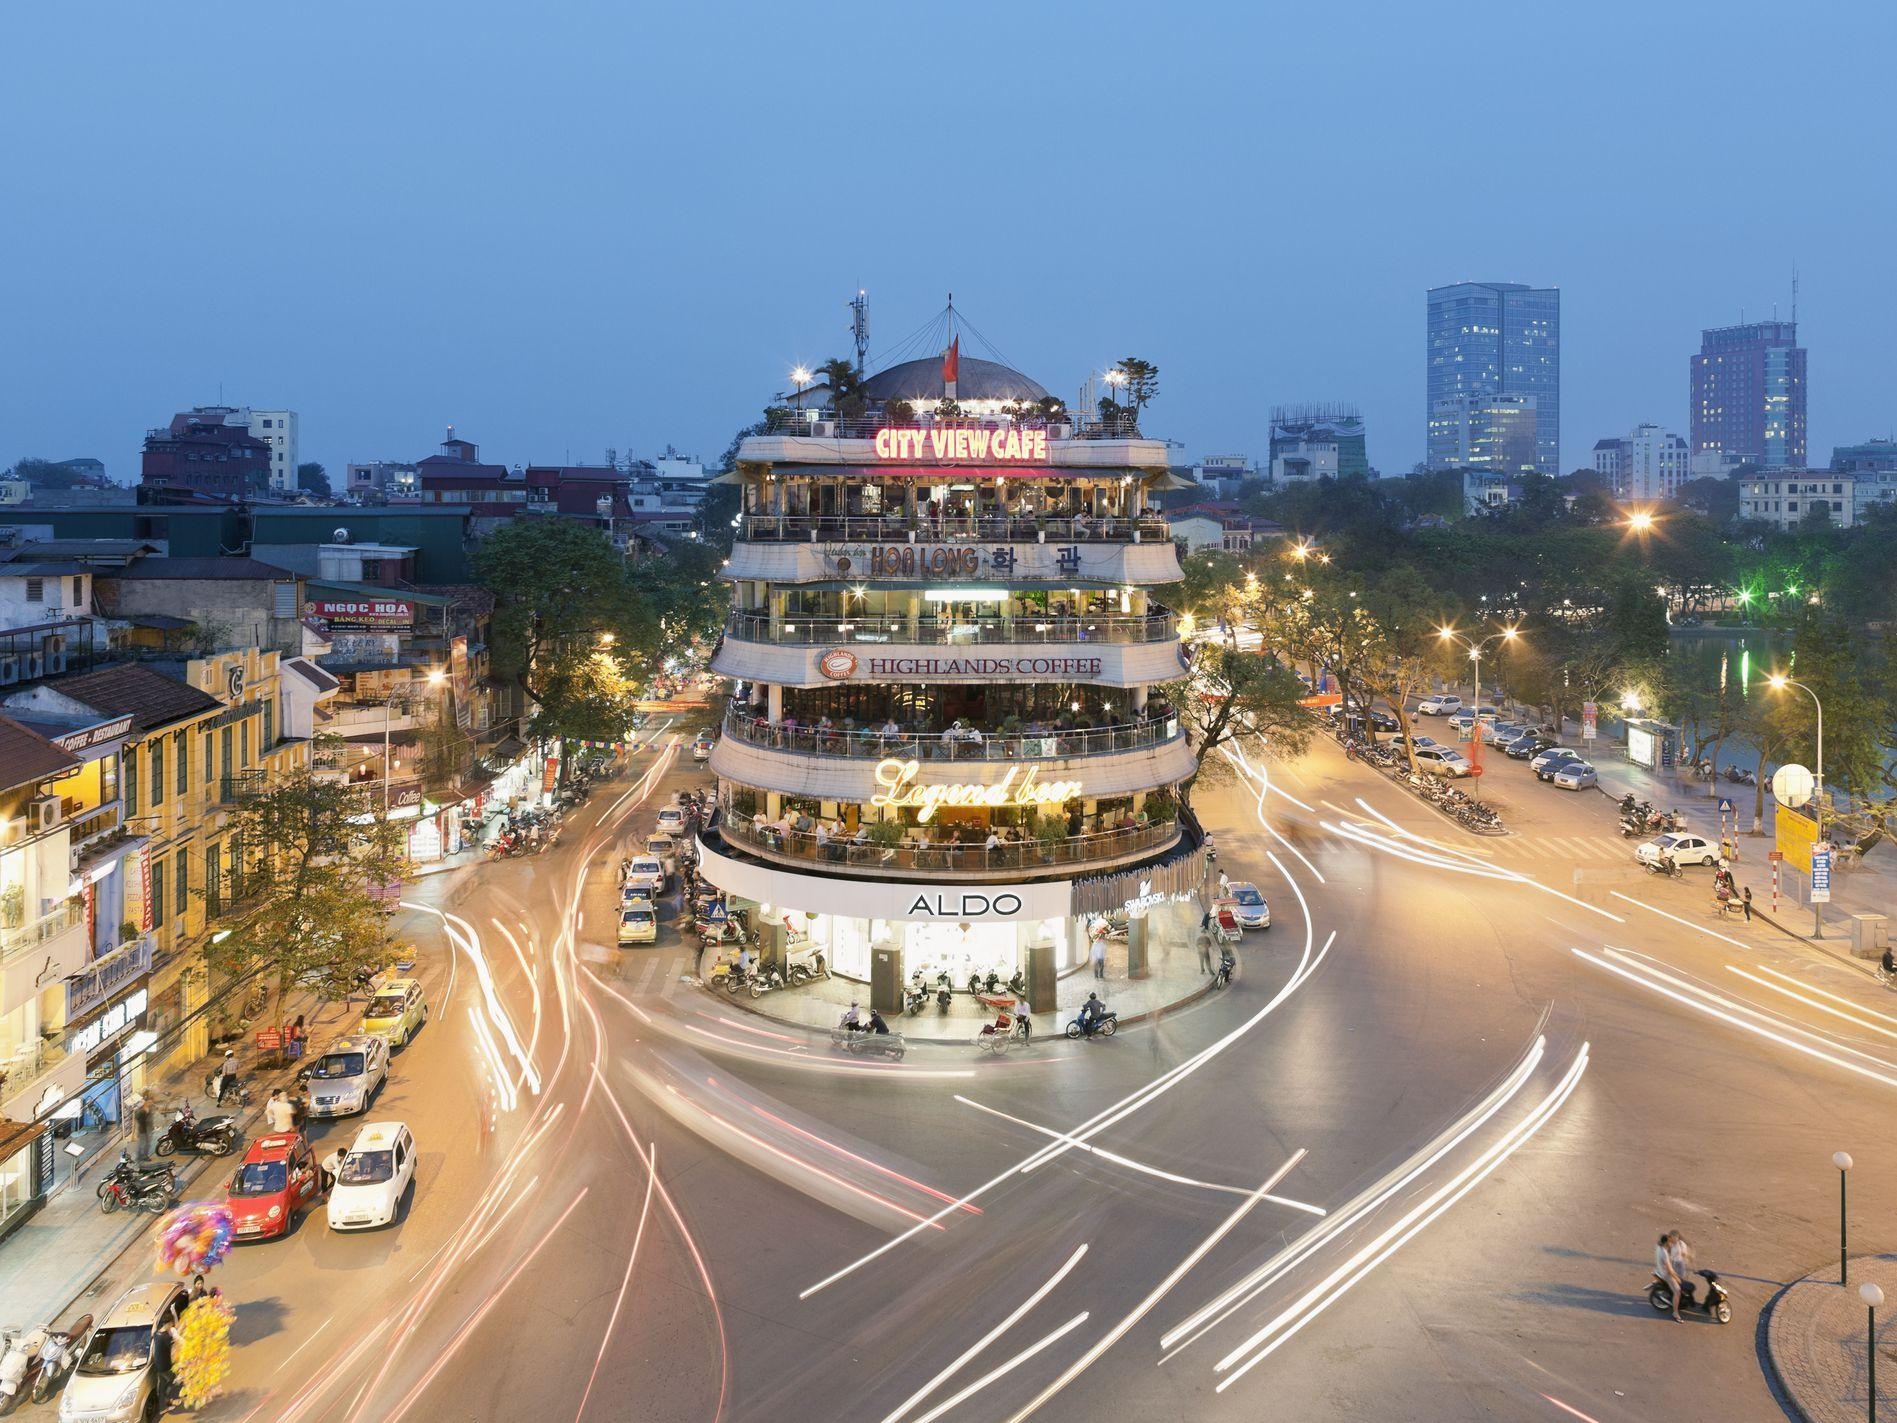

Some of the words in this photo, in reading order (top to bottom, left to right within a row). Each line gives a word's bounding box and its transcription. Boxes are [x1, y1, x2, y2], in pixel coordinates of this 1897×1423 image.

[875, 428, 927, 459] CITY
[930, 429, 990, 459] VIEW
[991, 430, 1047, 459] CAFE
[871, 546, 915, 577] HOA
[919, 547, 979, 575] LONG
[991, 547, 1018, 574] 화
[1055, 545, 1082, 573] 관
[374, 603, 409, 613] HOA
[823, 651, 855, 662] HIGHLANDS
[868, 658, 1012, 674] HIGHLANDS
[1015, 658, 1102, 674] COFFEE
[829, 670, 850, 678] COFFEE
[64, 733, 89, 752] COFFEE
[92, 719, 132, 744] RESTAURANT
[398, 790, 421, 806] Coffee
[870, 758, 1019, 823] Legend
[908, 893, 1022, 916] ALDO
